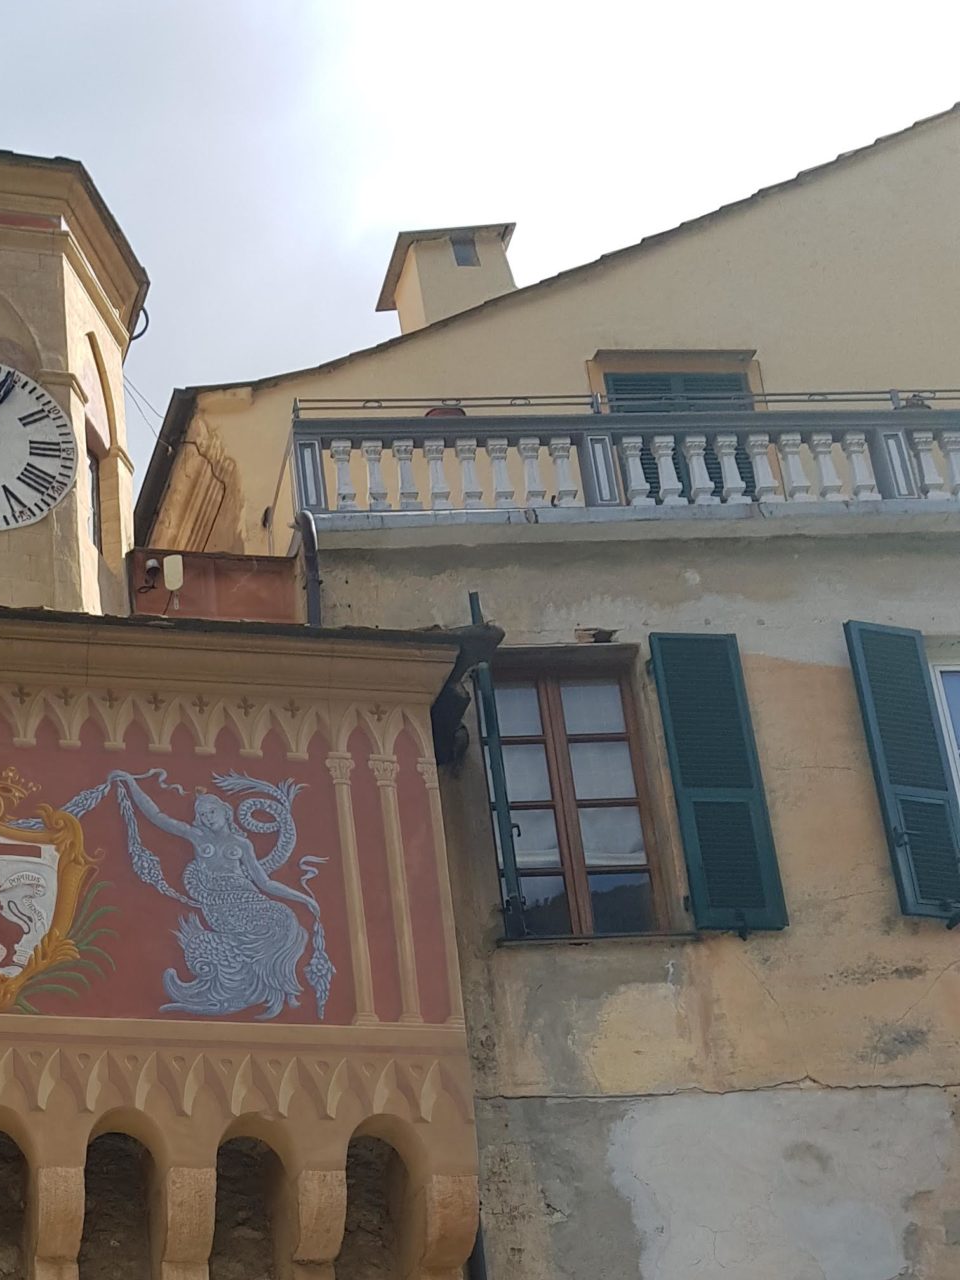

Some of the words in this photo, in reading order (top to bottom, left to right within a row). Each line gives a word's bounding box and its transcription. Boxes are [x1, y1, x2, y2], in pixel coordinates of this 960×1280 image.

[17, 407, 50, 428] II
[28, 440, 62, 458] III
[16, 461, 57, 497] IIII
[1, 484, 28, 515] V
